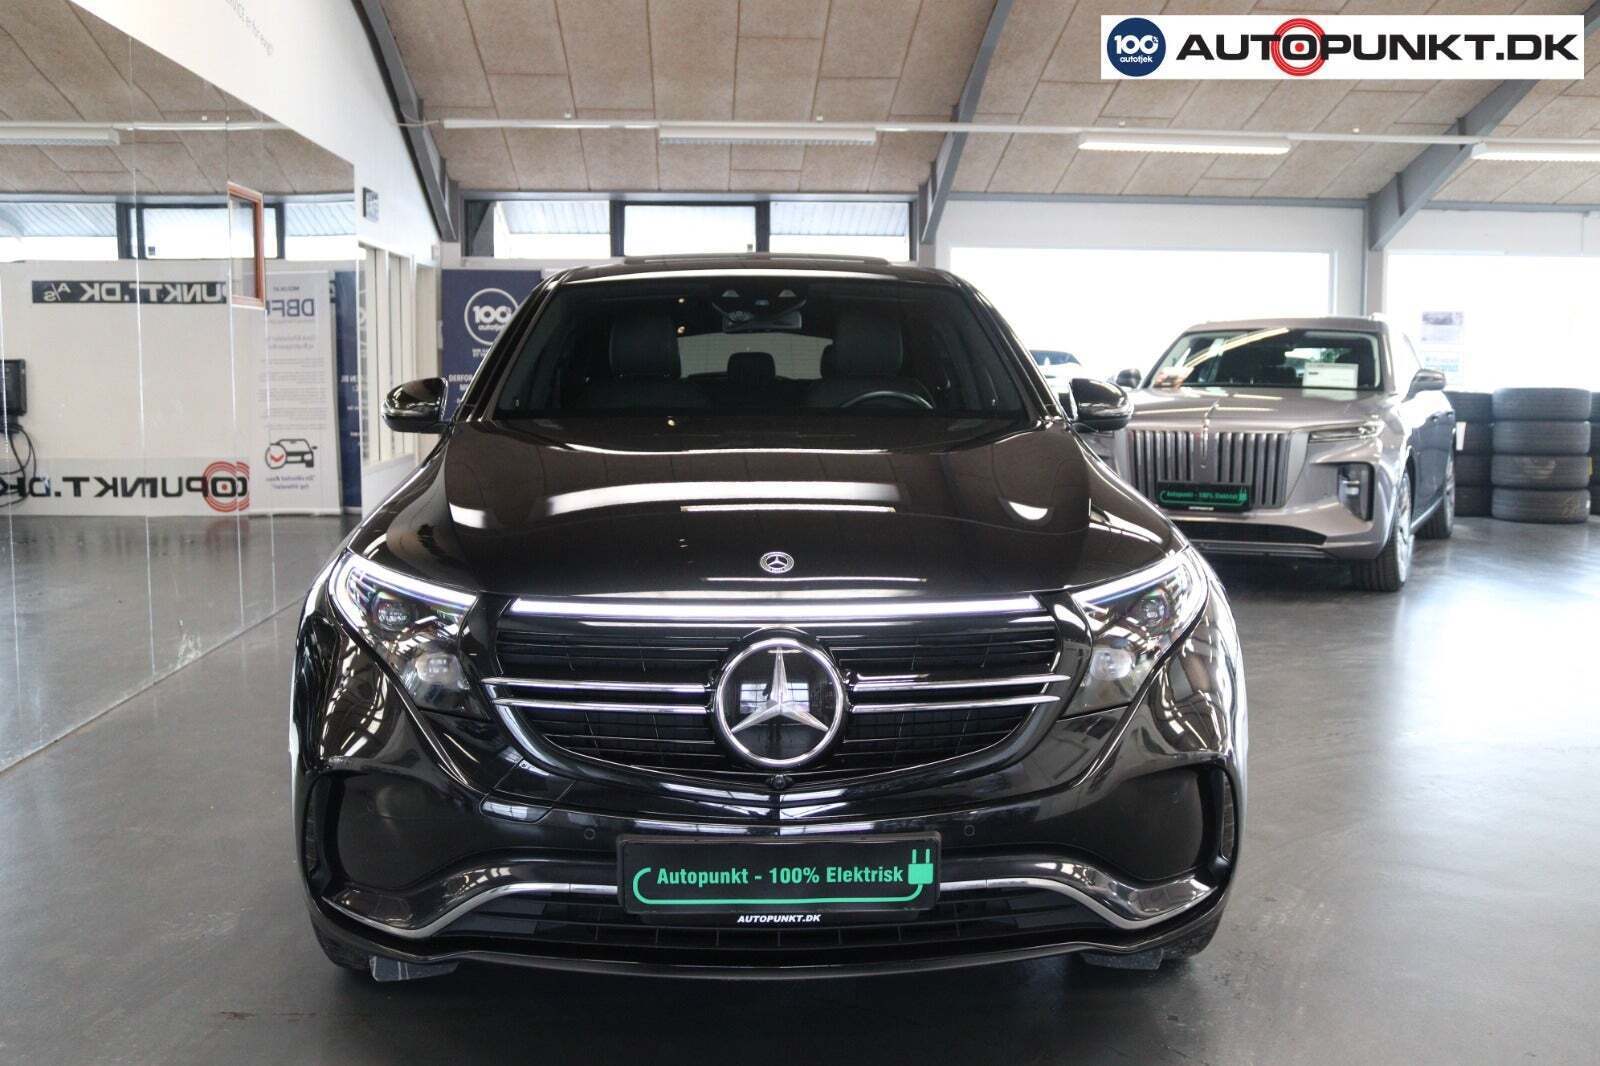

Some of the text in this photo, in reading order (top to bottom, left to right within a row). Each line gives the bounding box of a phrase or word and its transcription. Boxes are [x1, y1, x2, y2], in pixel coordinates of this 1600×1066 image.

[656, 867, 749, 888] Autopunkt
[769, 867, 820, 884] 100%
[826, 866, 904, 884] Elektrisk
[736, 913, 822, 924] AUTOPUNKT.DK
